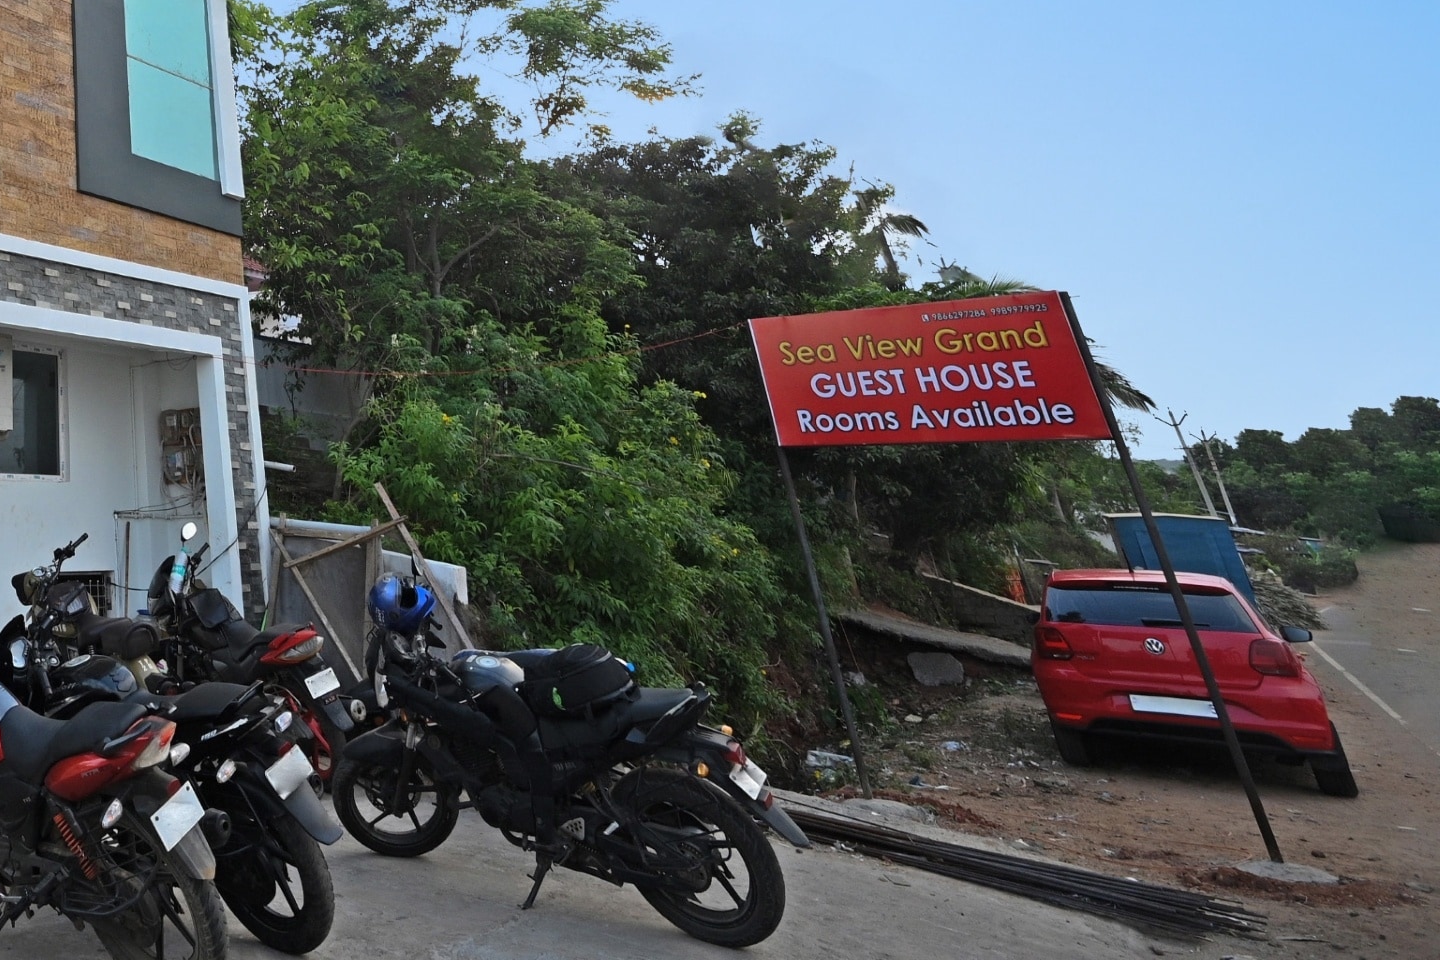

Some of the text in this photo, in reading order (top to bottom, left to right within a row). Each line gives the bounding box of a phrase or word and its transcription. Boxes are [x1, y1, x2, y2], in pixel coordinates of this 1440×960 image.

[777, 320, 1049, 367] Sea View Grand
[810, 360, 1036, 399] GUEST HOUSE
[796, 397, 1076, 434] Rooms Available
